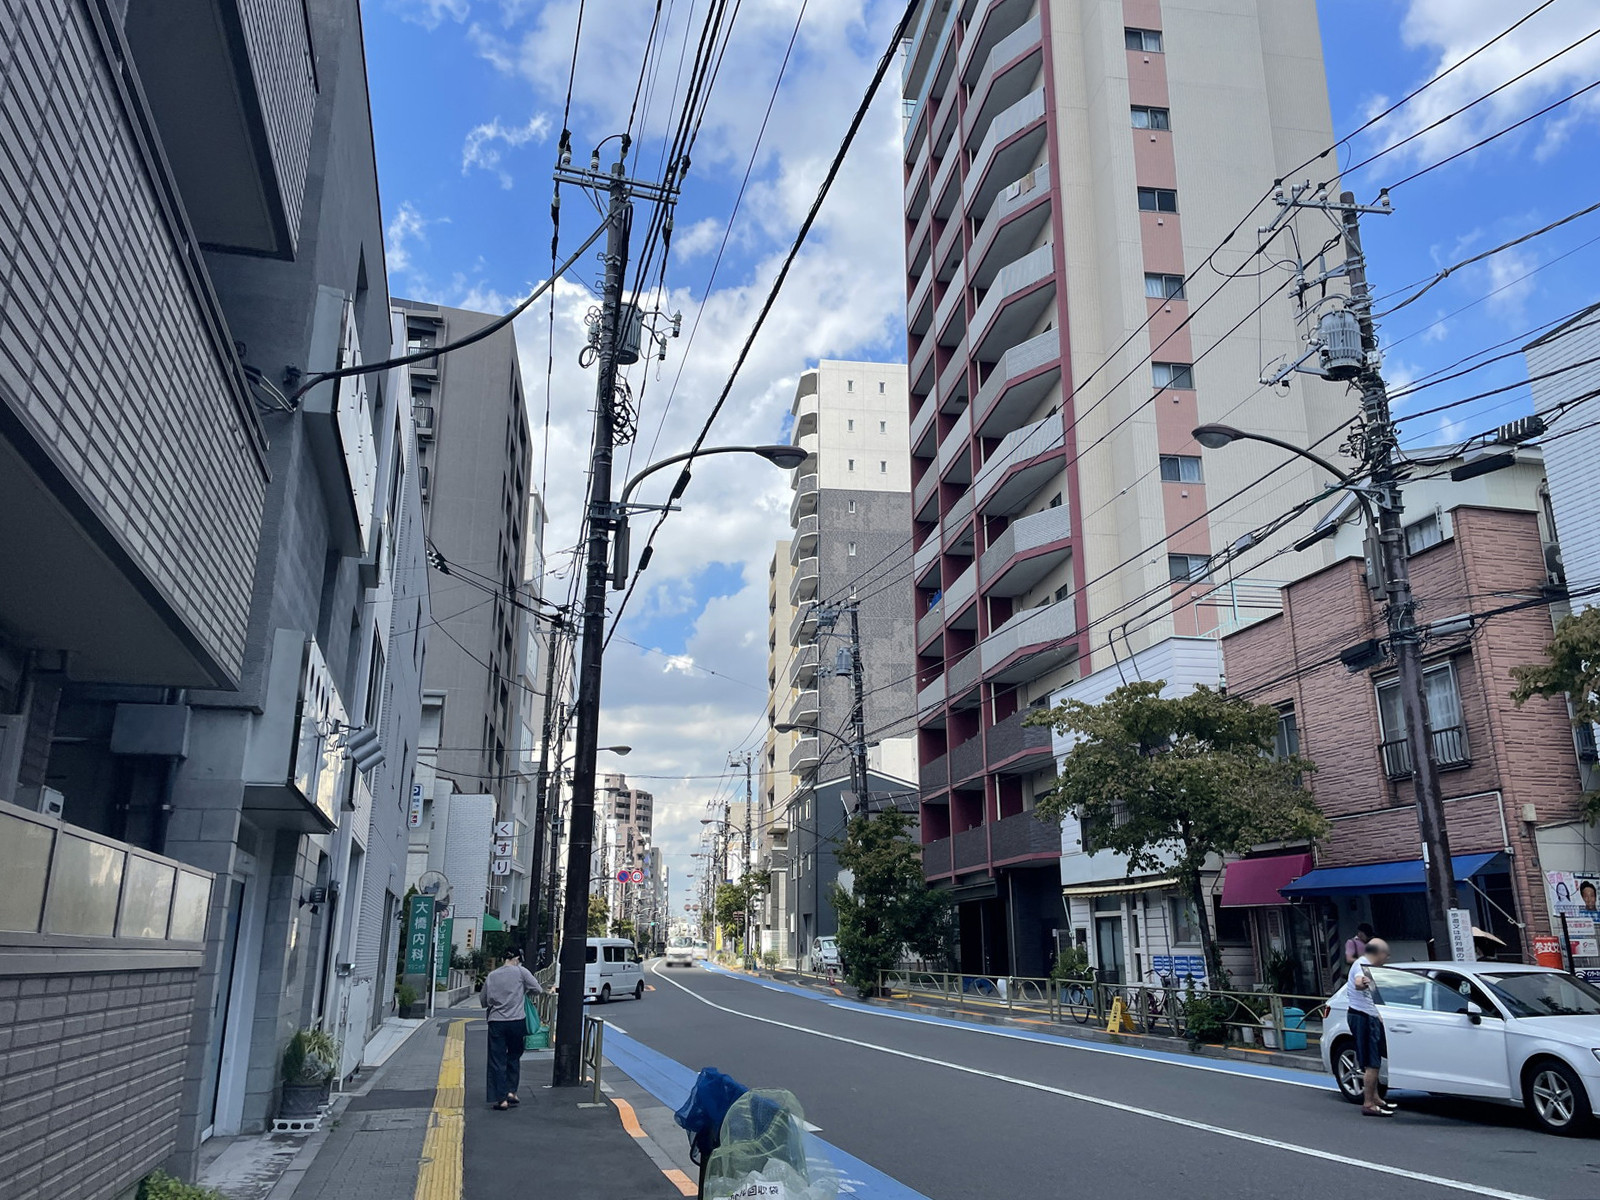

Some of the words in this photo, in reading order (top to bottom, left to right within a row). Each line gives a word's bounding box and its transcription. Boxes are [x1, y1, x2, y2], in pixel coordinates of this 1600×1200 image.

[497, 823, 510, 874] くすり
[411, 901, 429, 961] 大橋内科
